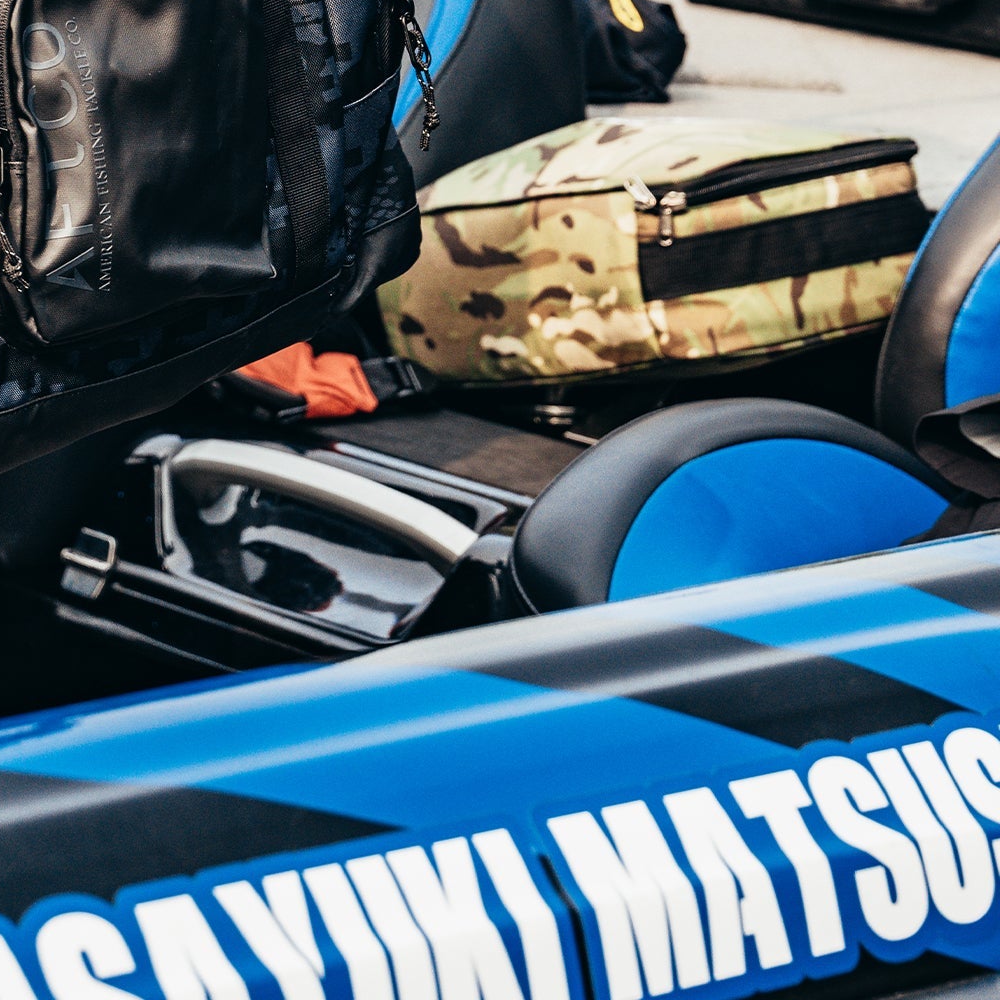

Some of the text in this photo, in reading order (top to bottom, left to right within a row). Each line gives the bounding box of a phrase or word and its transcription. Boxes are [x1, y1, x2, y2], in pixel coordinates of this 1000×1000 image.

[23, 22, 95, 292] AFTCO
[65, 16, 114, 292] AMERICAN FISHING TACKLE CO.
